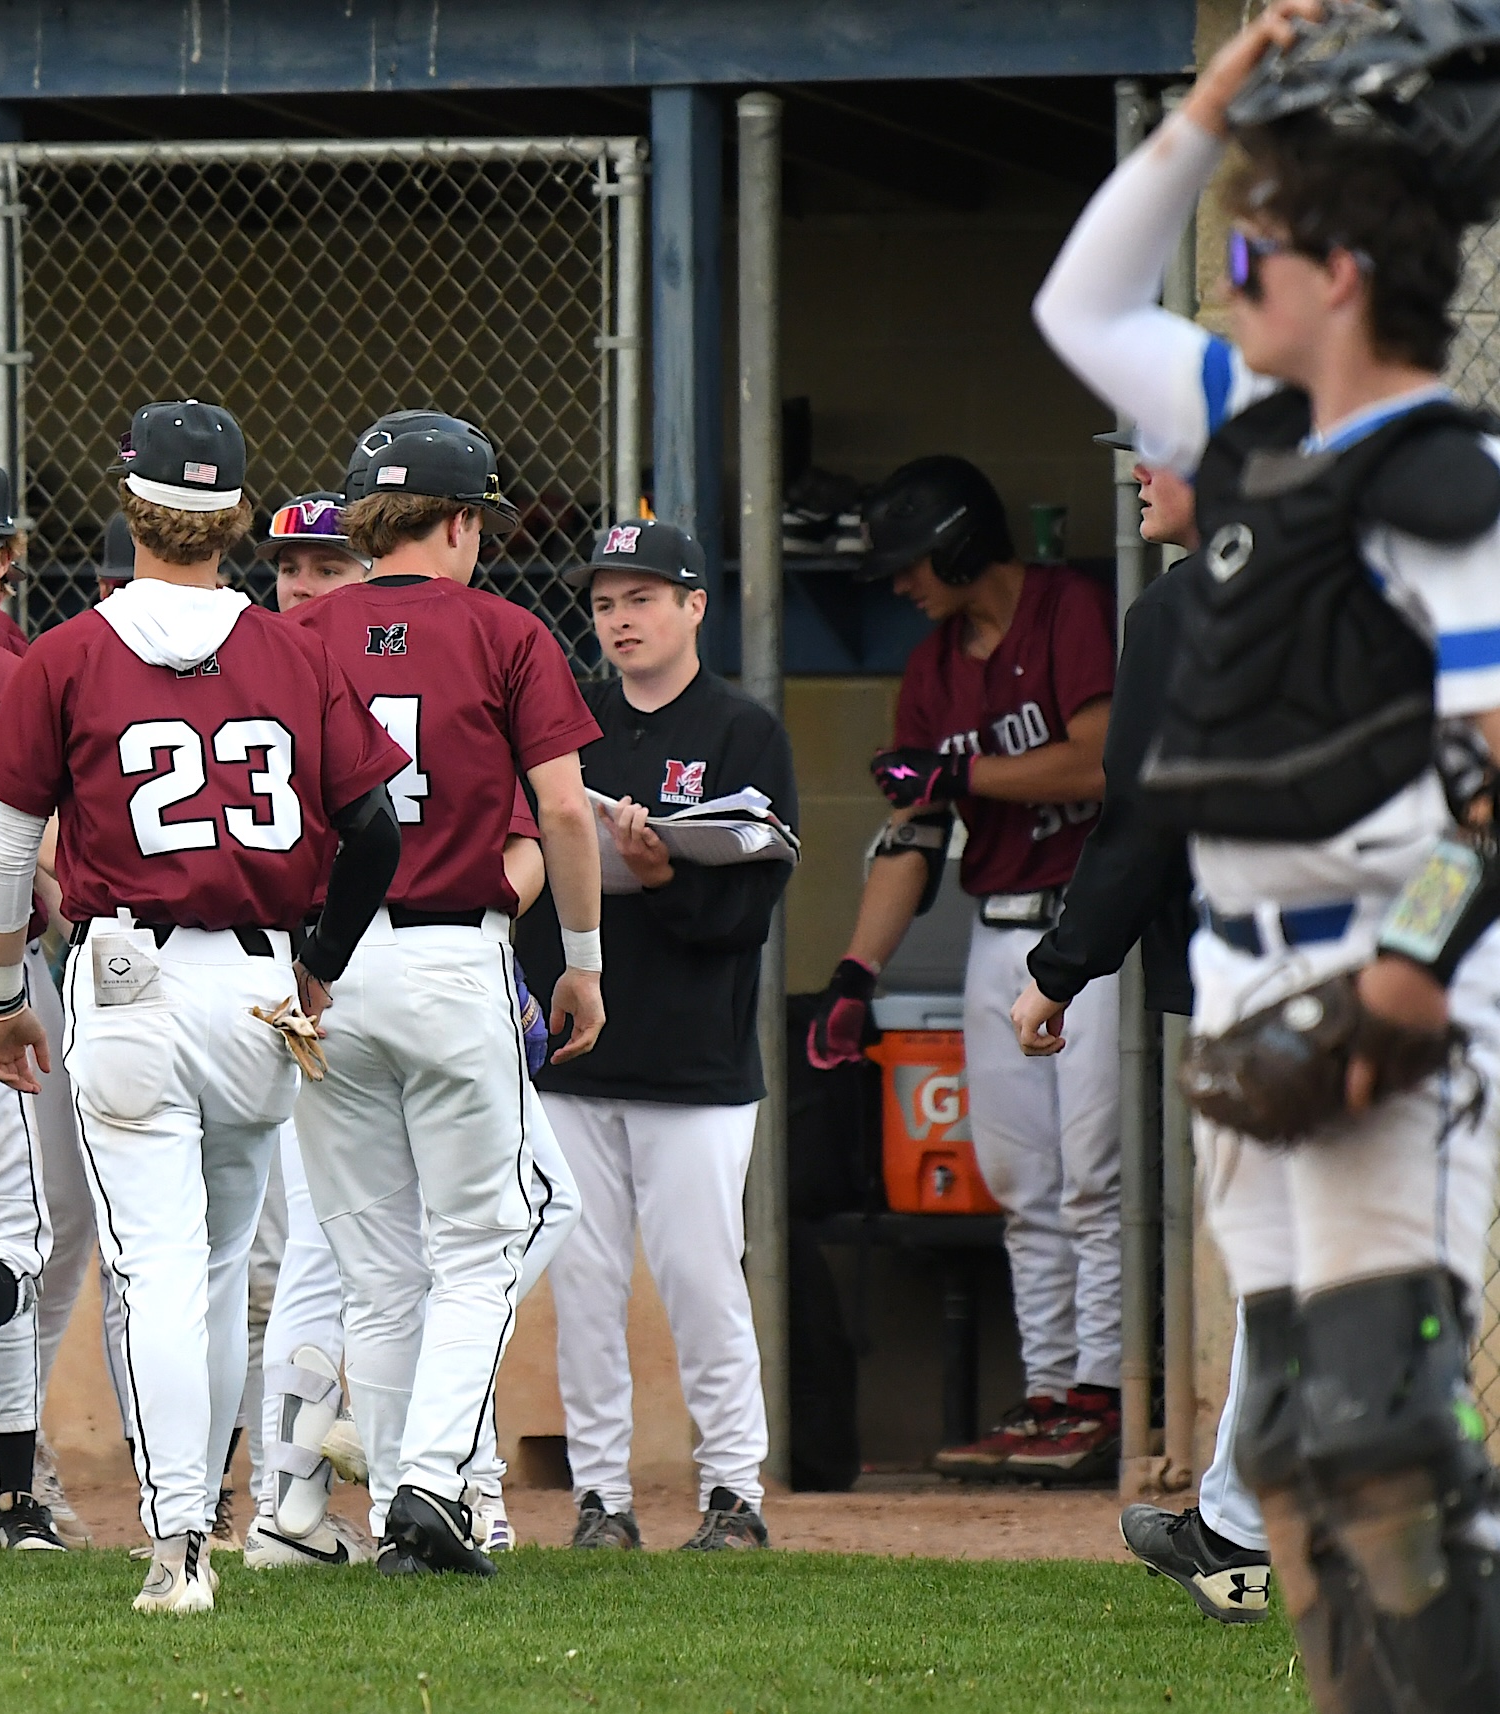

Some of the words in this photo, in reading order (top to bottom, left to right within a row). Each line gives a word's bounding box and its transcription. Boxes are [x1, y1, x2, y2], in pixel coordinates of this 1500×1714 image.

[603, 526, 641, 555] M
[365, 623, 408, 656] M
[117, 717, 304, 859] 23
[661, 760, 706, 797] M
[922, 1076, 960, 1124] G
